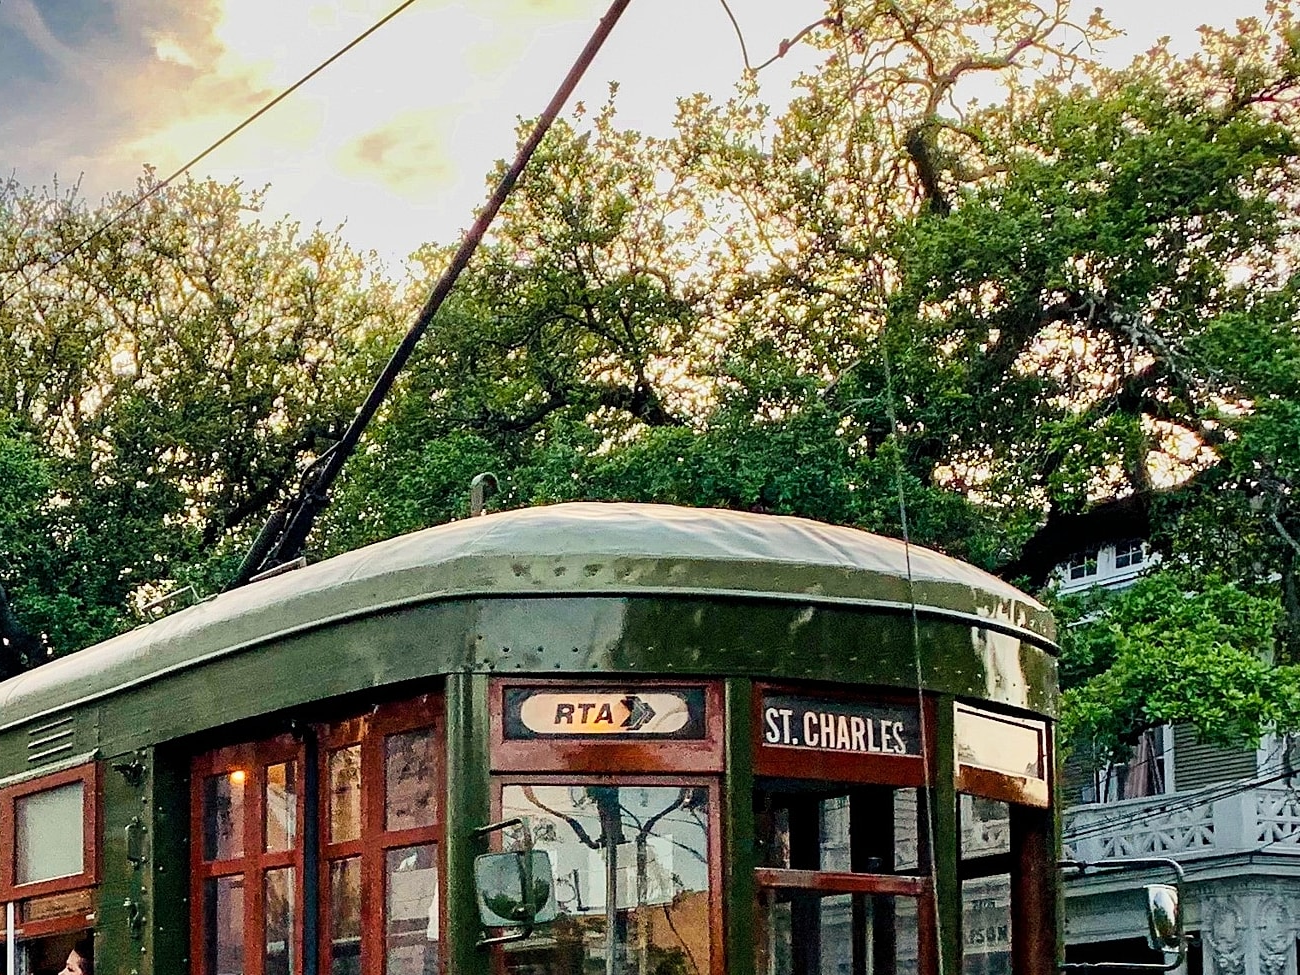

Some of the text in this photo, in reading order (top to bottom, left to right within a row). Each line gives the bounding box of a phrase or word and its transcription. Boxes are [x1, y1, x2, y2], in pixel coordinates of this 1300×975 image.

[553, 702, 614, 726] RTA
[765, 707, 908, 755] ST. CHARLES
